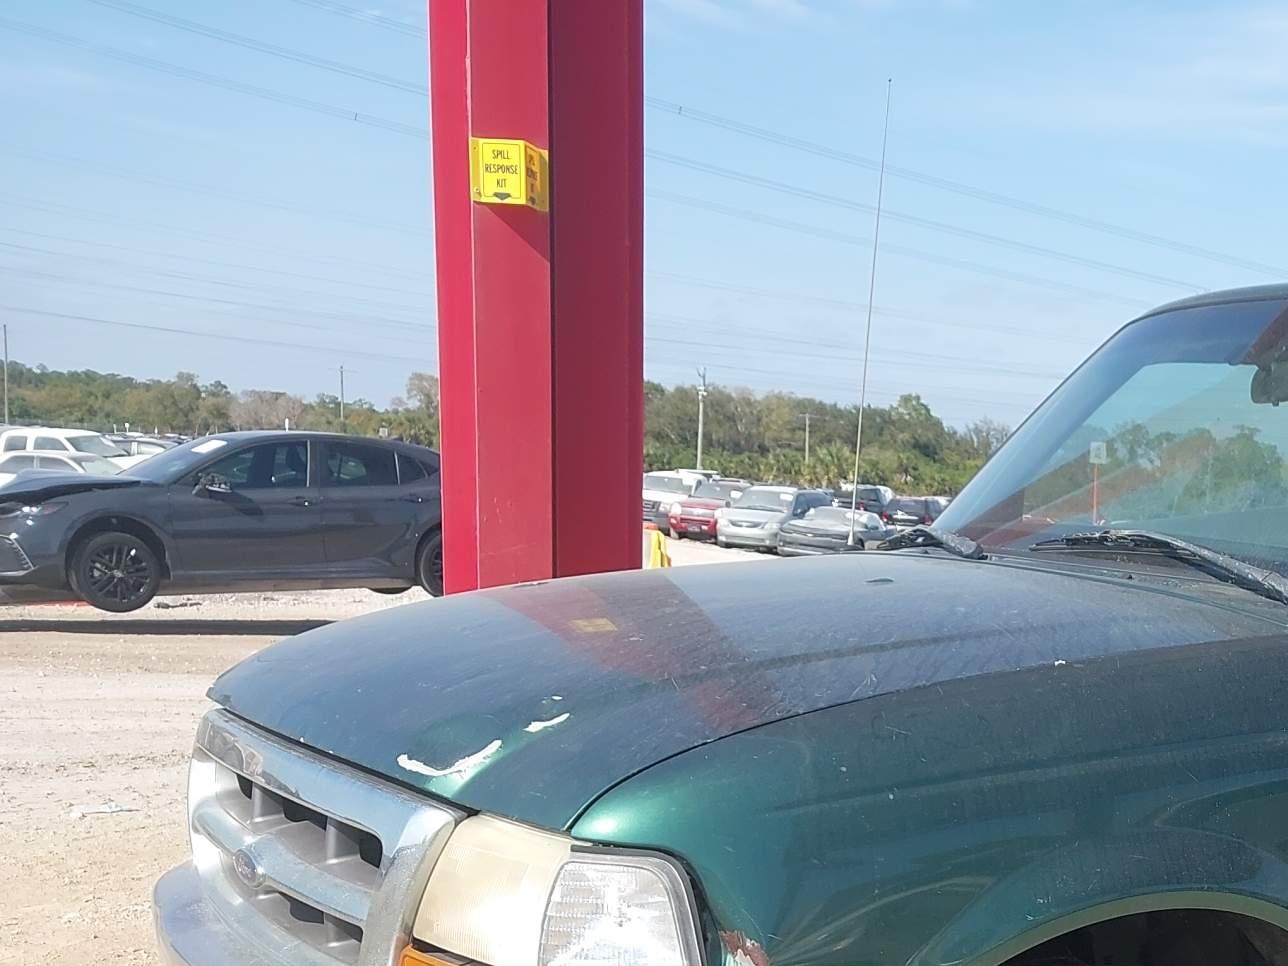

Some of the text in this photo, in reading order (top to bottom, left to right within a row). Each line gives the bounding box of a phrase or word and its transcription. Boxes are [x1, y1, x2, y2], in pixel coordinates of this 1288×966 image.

[492, 149, 510, 160] SPILL
[485, 163, 518, 175] RESPONSE
[496, 178, 507, 188] KIT
